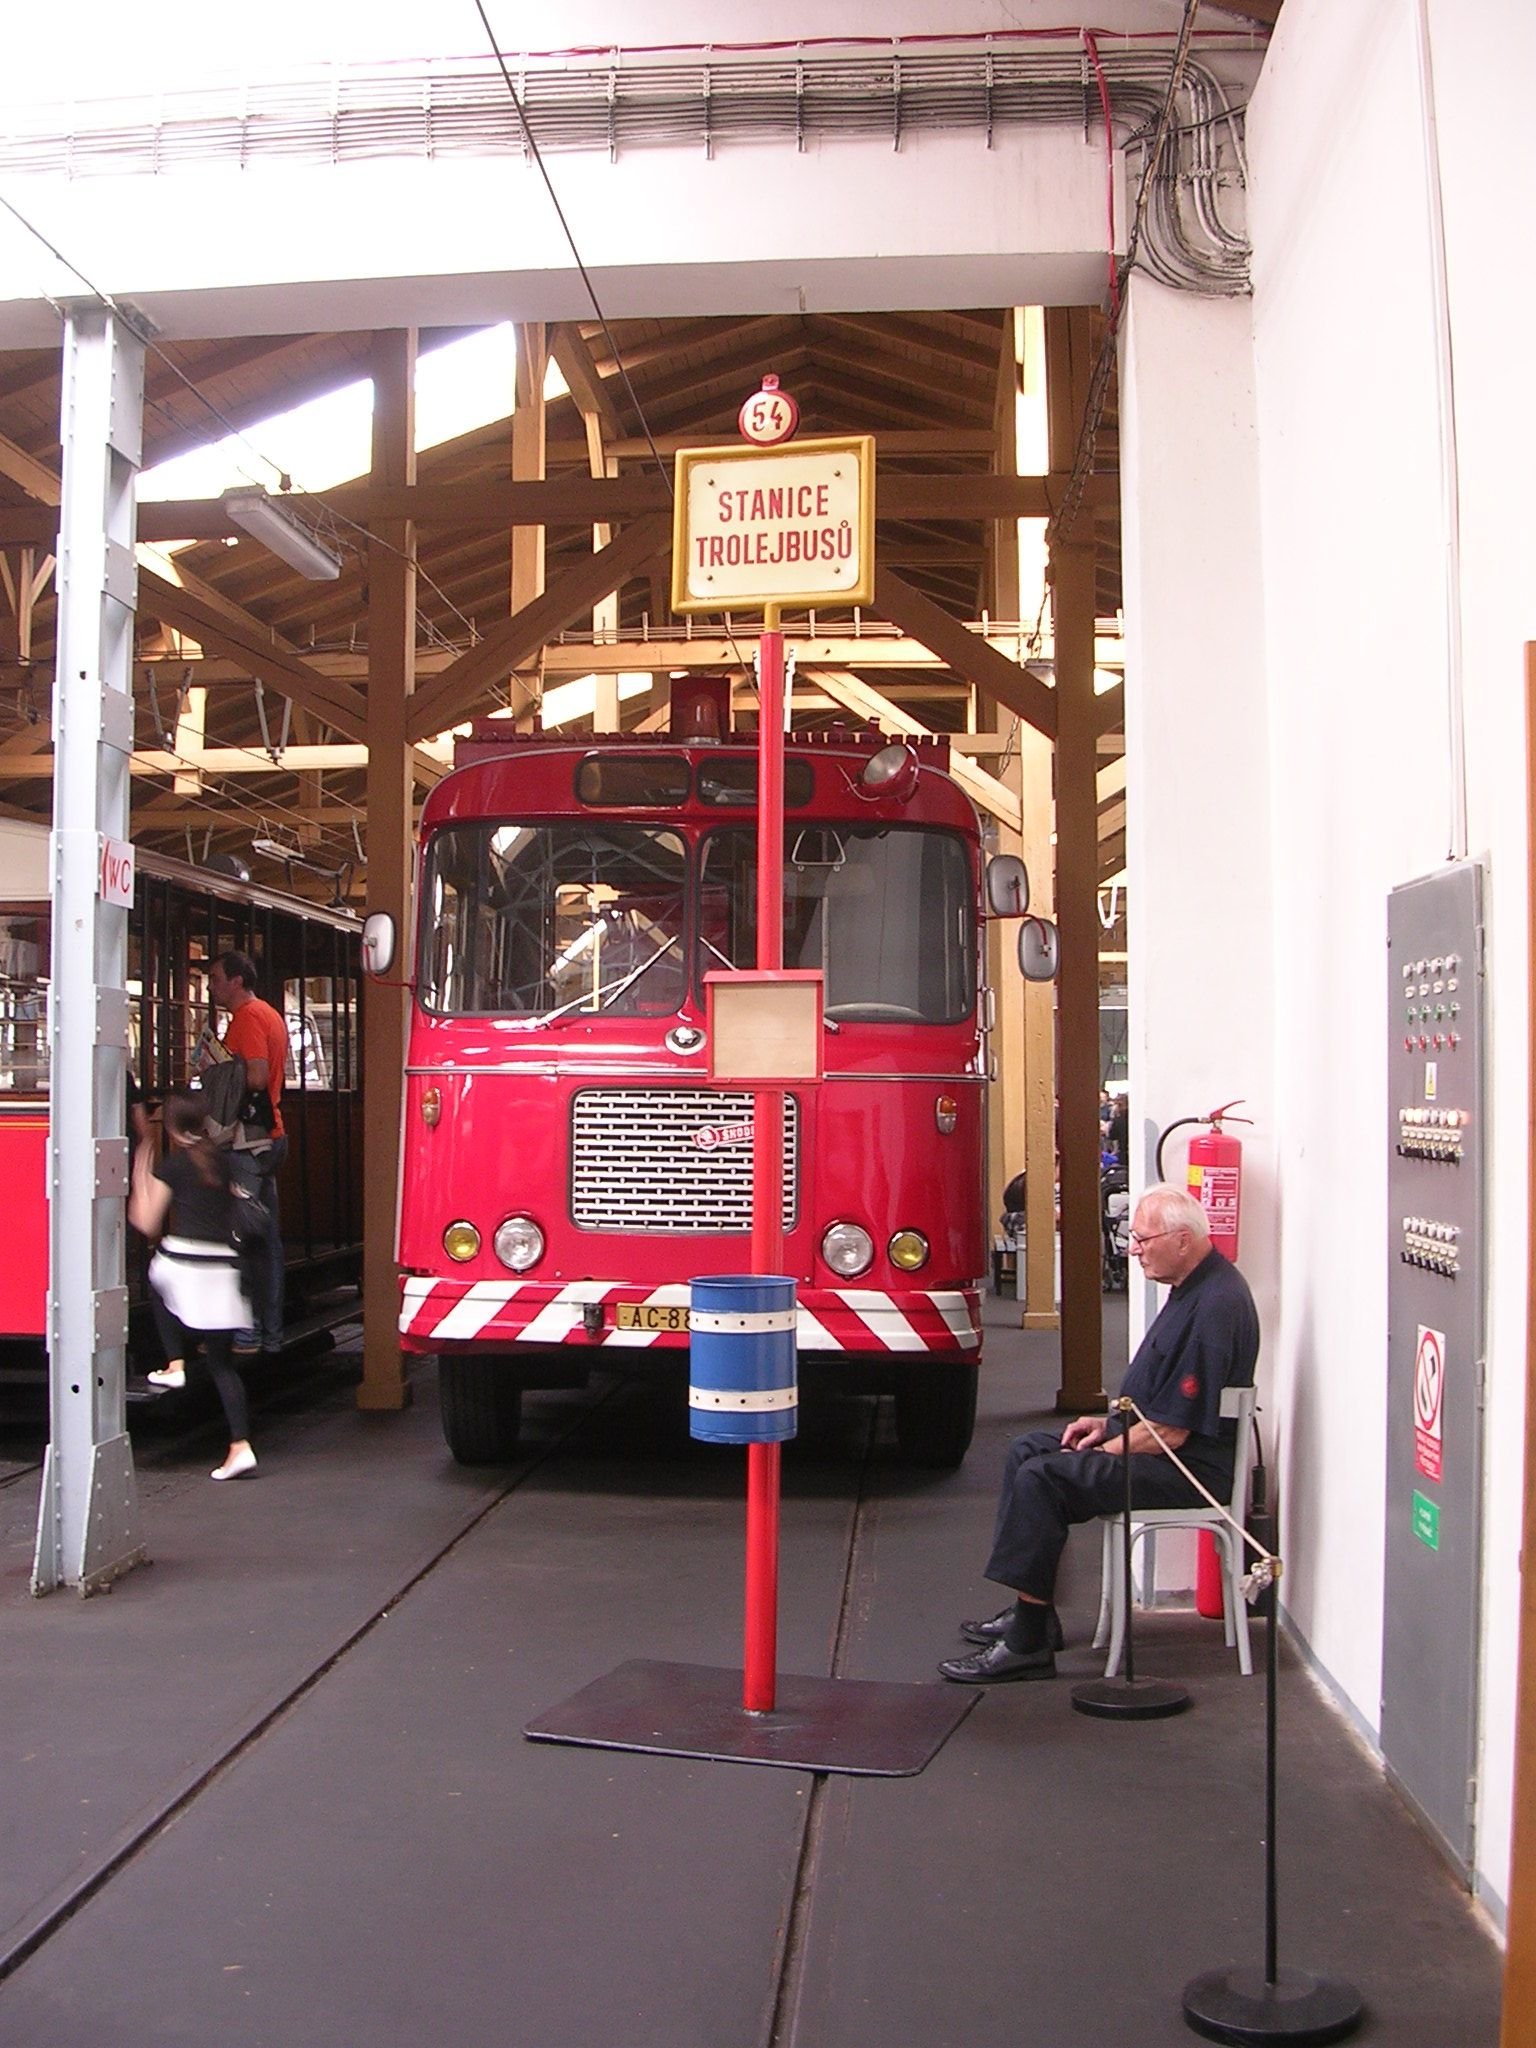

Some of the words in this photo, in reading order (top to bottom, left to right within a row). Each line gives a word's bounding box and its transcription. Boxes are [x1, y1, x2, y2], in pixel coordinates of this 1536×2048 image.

[752, 401, 783, 432] 54
[718, 484, 829, 523] STANICE
[696, 519, 852, 567] TROLEJBUSŮ
[109, 855, 131, 893] WC
